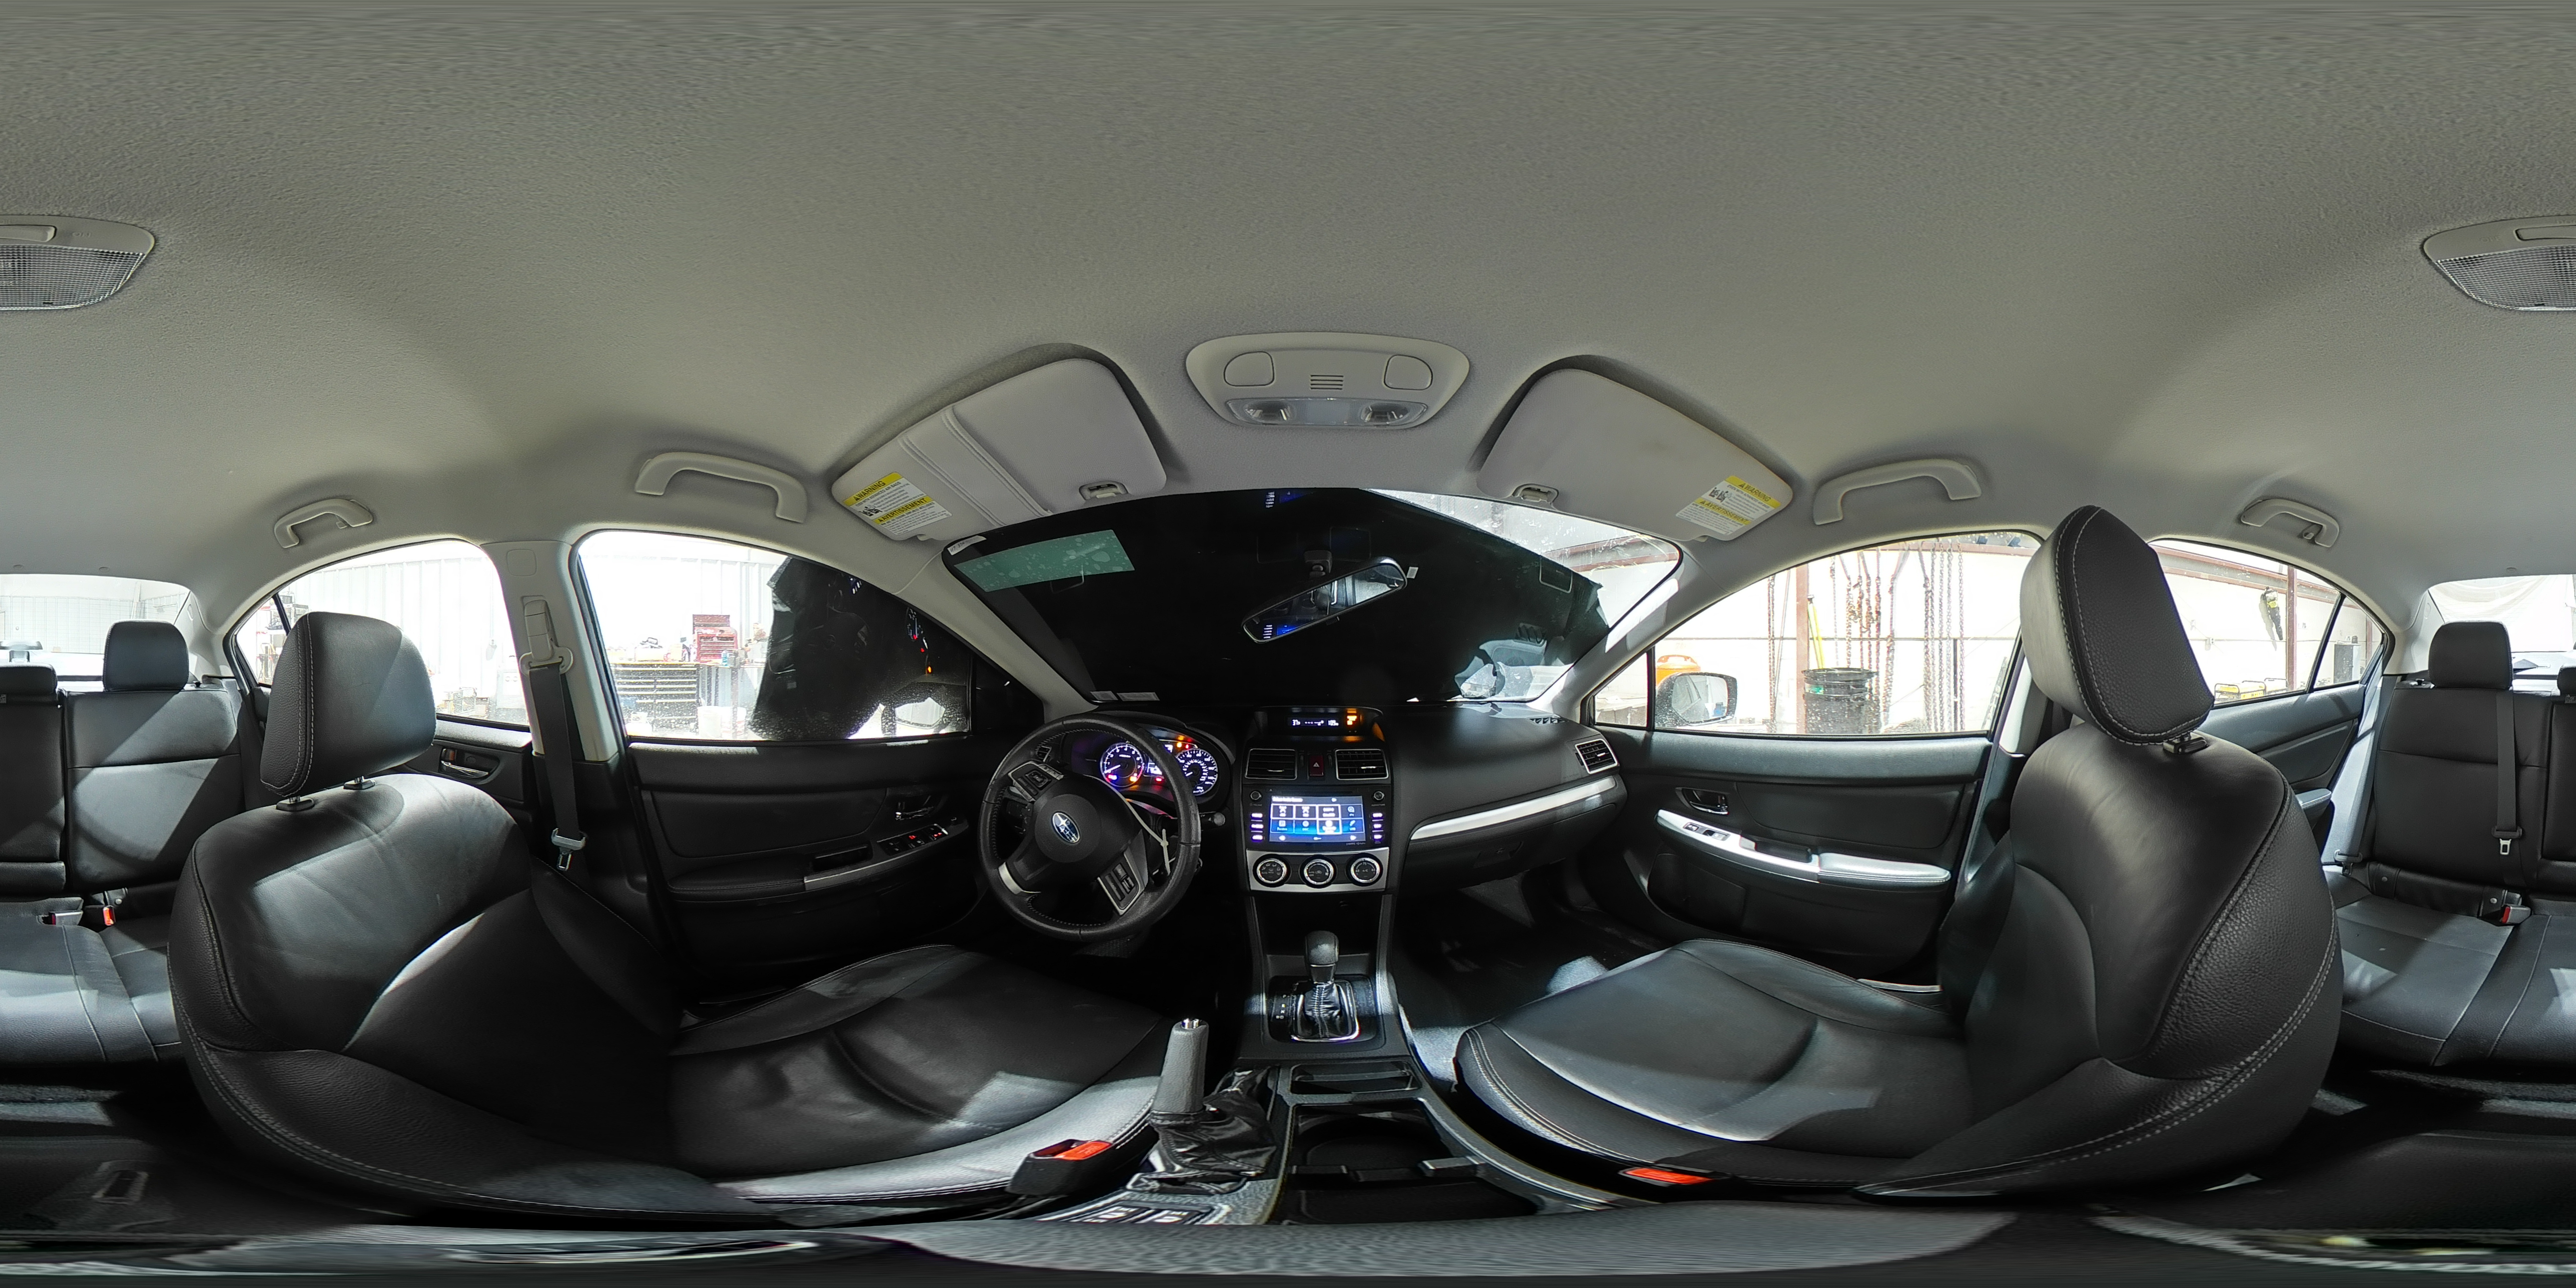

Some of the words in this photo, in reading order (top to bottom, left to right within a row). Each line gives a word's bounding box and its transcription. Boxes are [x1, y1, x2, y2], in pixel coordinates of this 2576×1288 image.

[856, 481, 886, 498] WARNING
[869, 490, 886, 500] ADVANCED
[1745, 484, 1771, 502] WARNING
[882, 498, 928, 522] AVERTISSEMENT
[1705, 500, 1749, 523] AVERTISSEMENT
